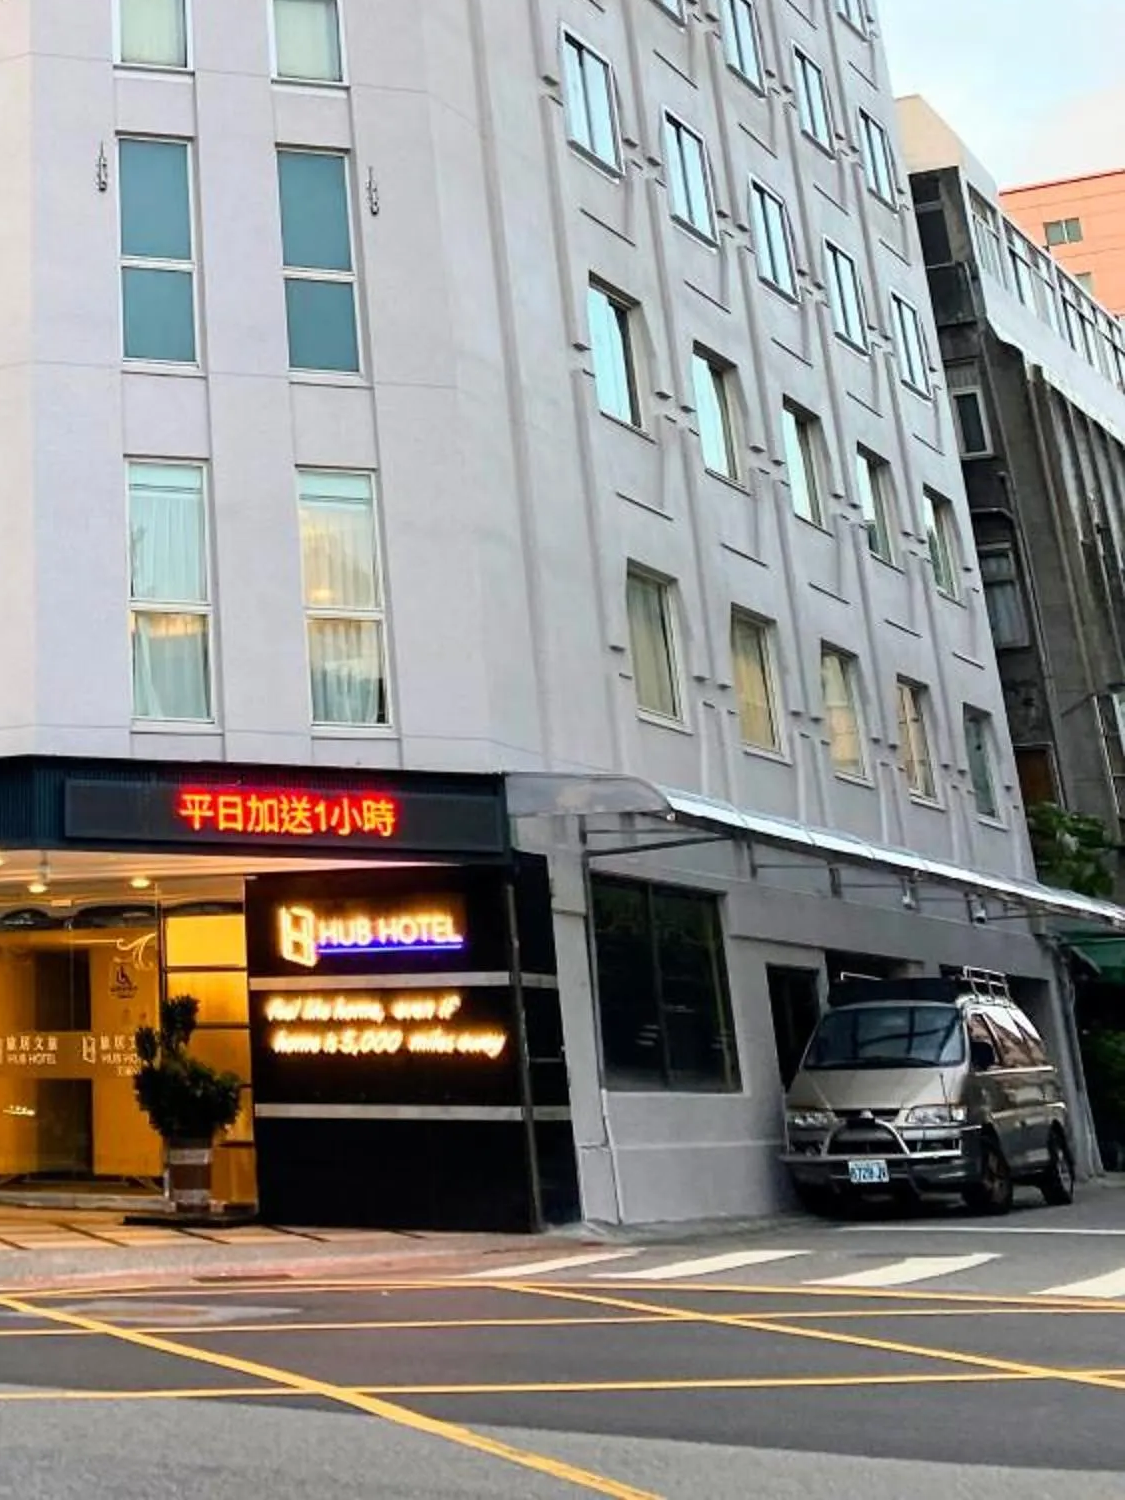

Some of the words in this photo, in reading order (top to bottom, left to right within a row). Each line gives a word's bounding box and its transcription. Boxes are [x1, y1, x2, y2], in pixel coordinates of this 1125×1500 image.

[178, 793, 397, 838] 平日加送1小時
[318, 916, 372, 947] HUB
[378, 913, 465, 944] HOTEL
